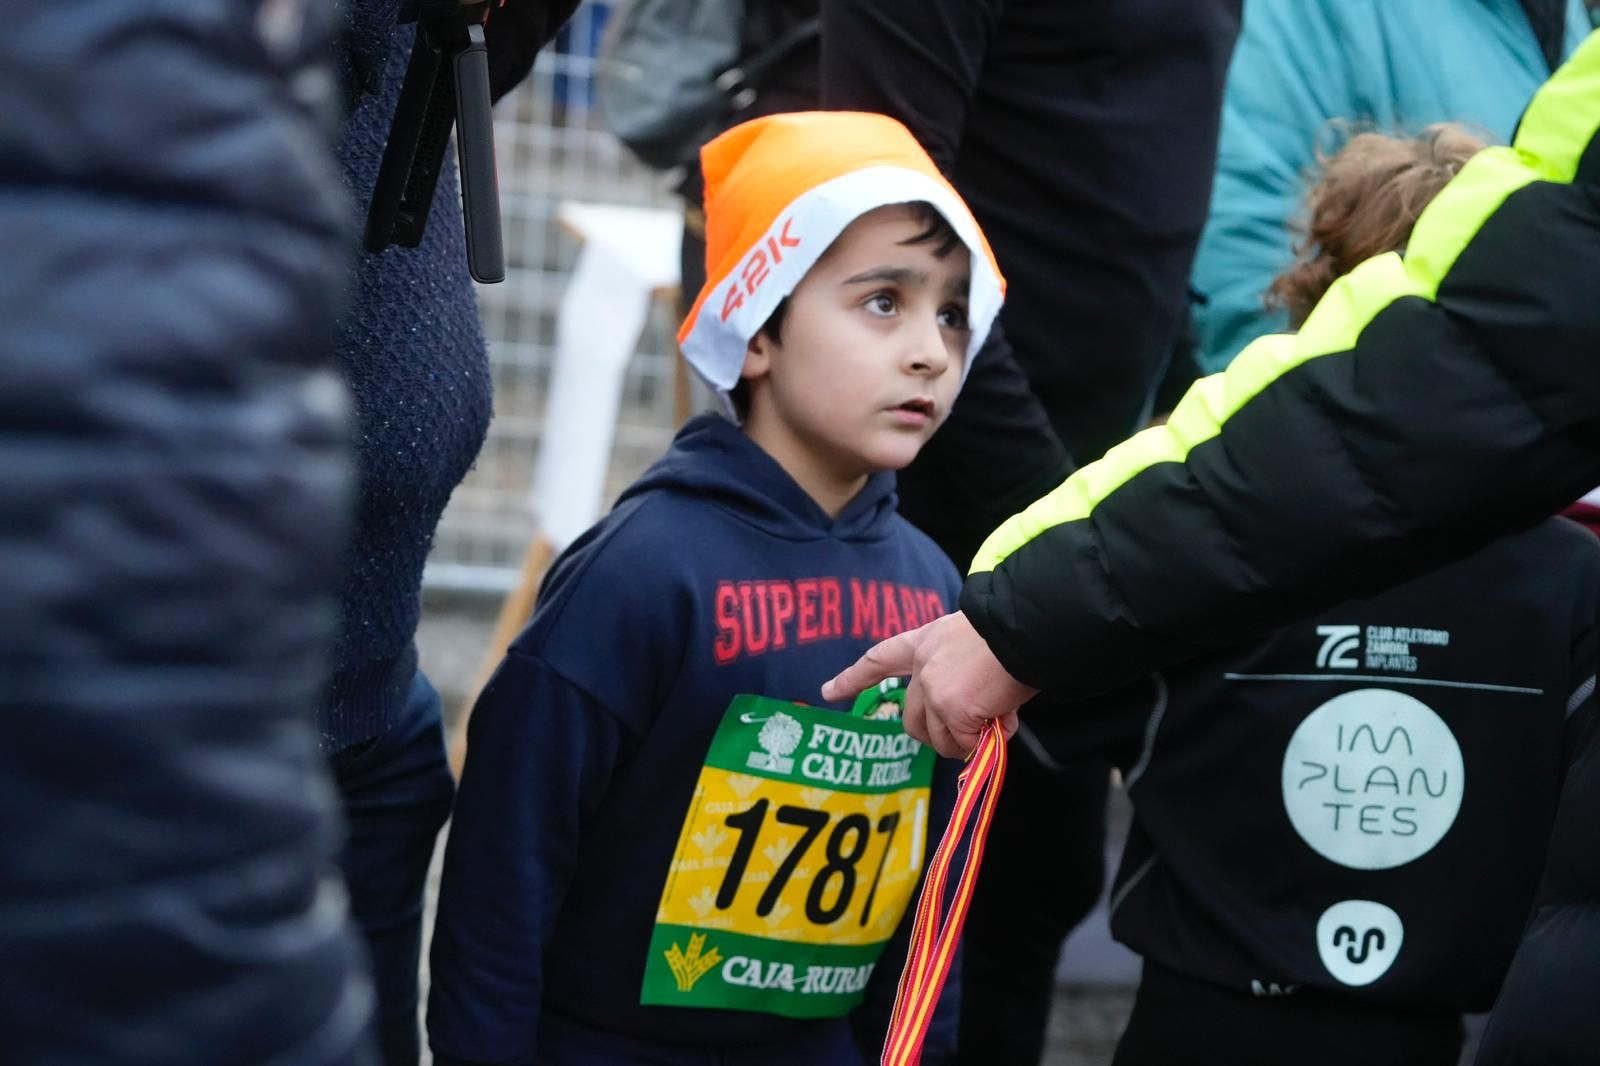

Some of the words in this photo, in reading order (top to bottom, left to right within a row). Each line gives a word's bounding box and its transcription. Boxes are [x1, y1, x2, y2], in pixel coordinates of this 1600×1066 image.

[720, 216, 801, 323] 42K
[714, 577, 843, 666] SUPER
[1365, 625, 1393, 641] CLUB
[1365, 640, 1410, 656] ZAMORA
[1365, 655, 1418, 672] IMPLANTES
[1337, 723, 1413, 755] IM
[802, 752, 863, 786] CAJA
[1299, 761, 1448, 798] PLAN
[1322, 803, 1418, 836] TES
[722, 955, 795, 992] CAJA
